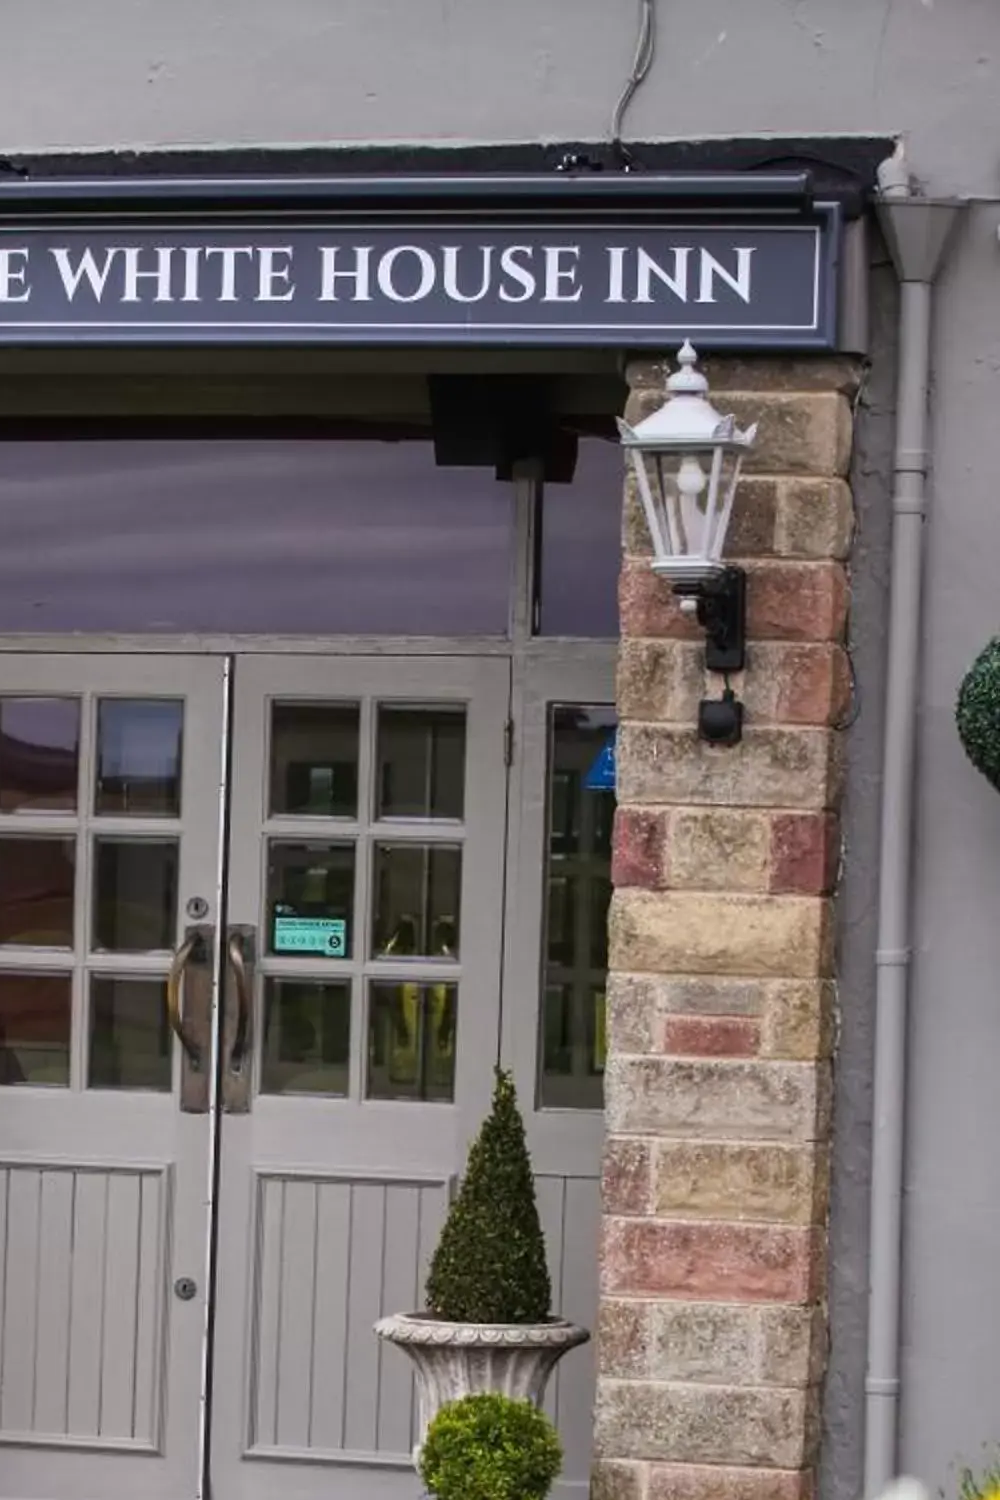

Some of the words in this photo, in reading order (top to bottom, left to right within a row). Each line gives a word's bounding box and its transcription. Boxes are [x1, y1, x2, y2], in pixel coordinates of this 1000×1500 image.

[48, 245, 297, 304] WHITE
[316, 244, 583, 303] HOUSE
[604, 244, 756, 304] INN
